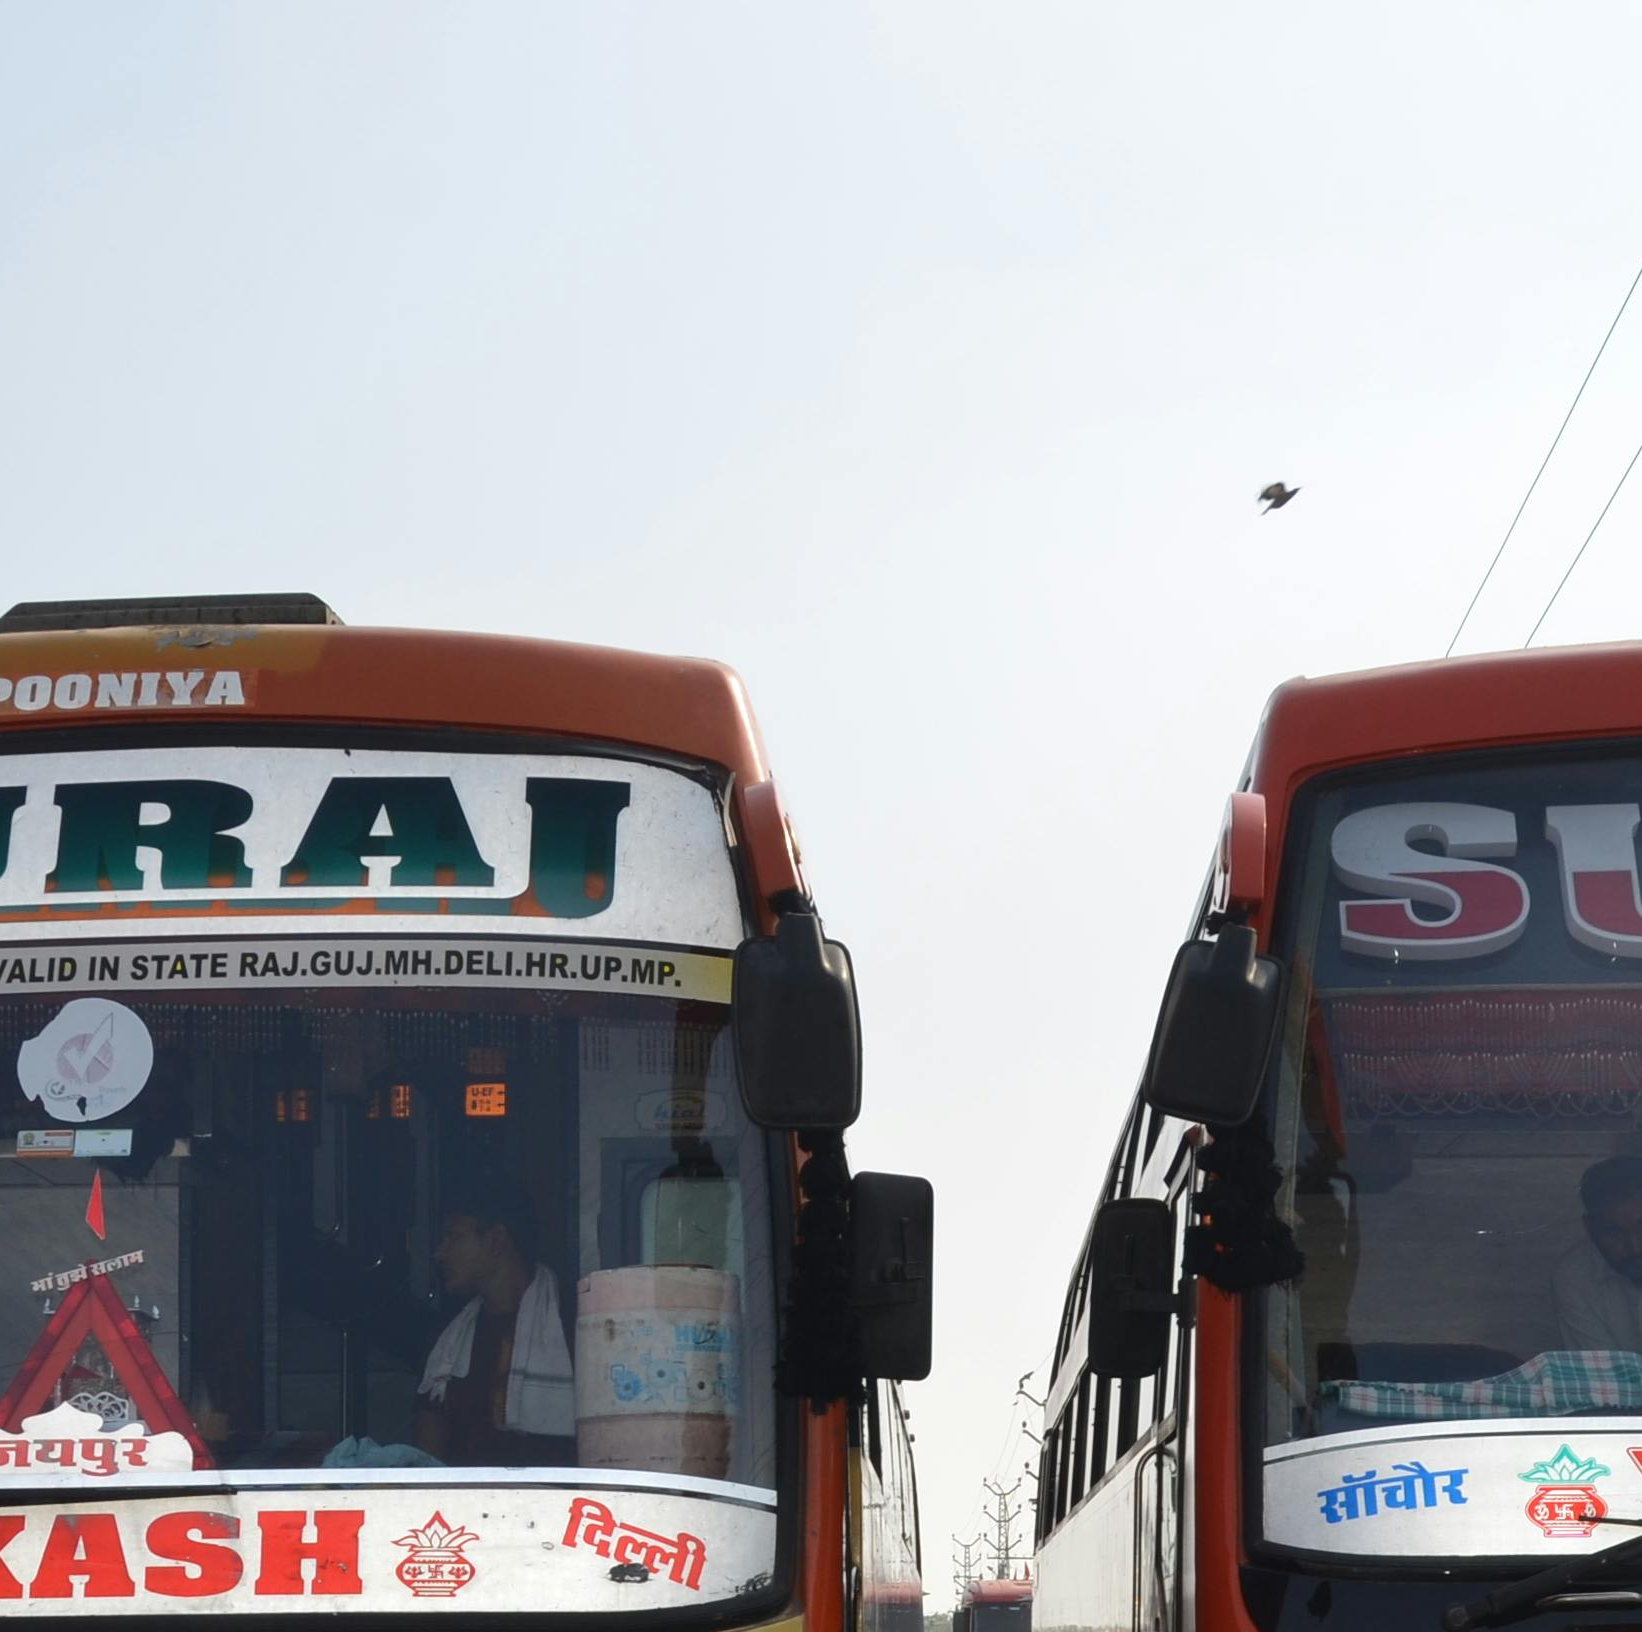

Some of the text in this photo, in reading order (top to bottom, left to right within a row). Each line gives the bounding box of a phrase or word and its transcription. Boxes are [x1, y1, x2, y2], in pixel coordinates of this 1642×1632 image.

[89, 955, 121, 982] IN
[130, 952, 228, 981] STATE
[239, 949, 682, 988] RAJ.GUJ.MH.DELI.HR.UP.MP.
[55, 1264, 88, 1291] तुझे
[90, 1249, 145, 1276] सलाम
[562, 1497, 707, 1591] दिल्ली
